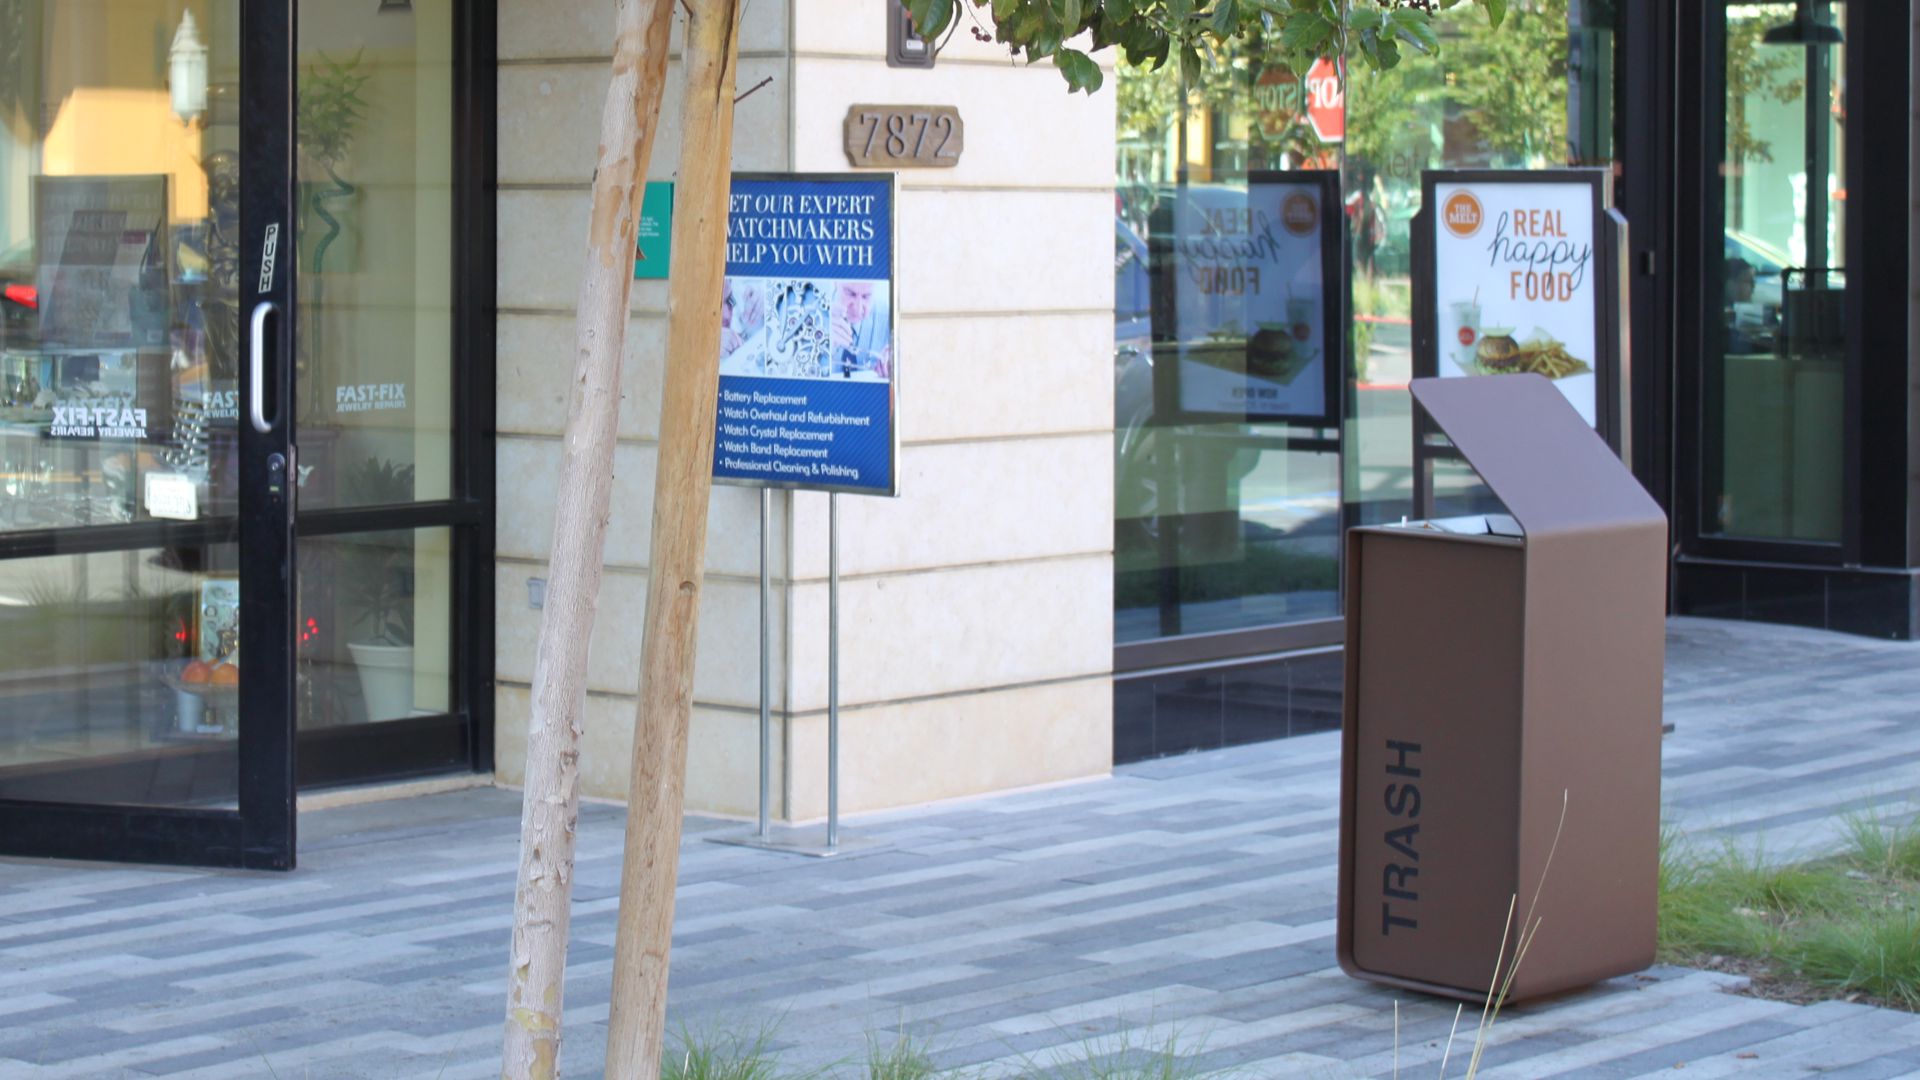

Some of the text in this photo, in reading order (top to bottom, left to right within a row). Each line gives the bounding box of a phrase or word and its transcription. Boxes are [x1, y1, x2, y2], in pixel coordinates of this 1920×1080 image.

[860, 112, 957, 158] 7872
[729, 194, 875, 215] ET OUR EXPERT
[1449, 212, 1477, 224] MELT
[1513, 208, 1568, 237] REAL
[260, 226, 276, 291] PUSH
[770, 243, 811, 265] YOU
[815, 244, 873, 266] WITH
[1487, 211, 1592, 291] happy
[1510, 271, 1572, 301] FOOD
[336, 383, 405, 402] FAST-FIX
[724, 390, 807, 406] Battery Replacement
[336, 402, 373, 412] JEWELRY
[724, 407, 870, 426] Watch Overhaul and Refurbishment
[724, 424, 833, 441] Watch Crystal Replacement
[724, 441, 828, 458] Watch Band Replacement
[725, 458, 859, 480] Professional Cleaning & Polishing
[1382, 739, 1422, 936] TRASH
